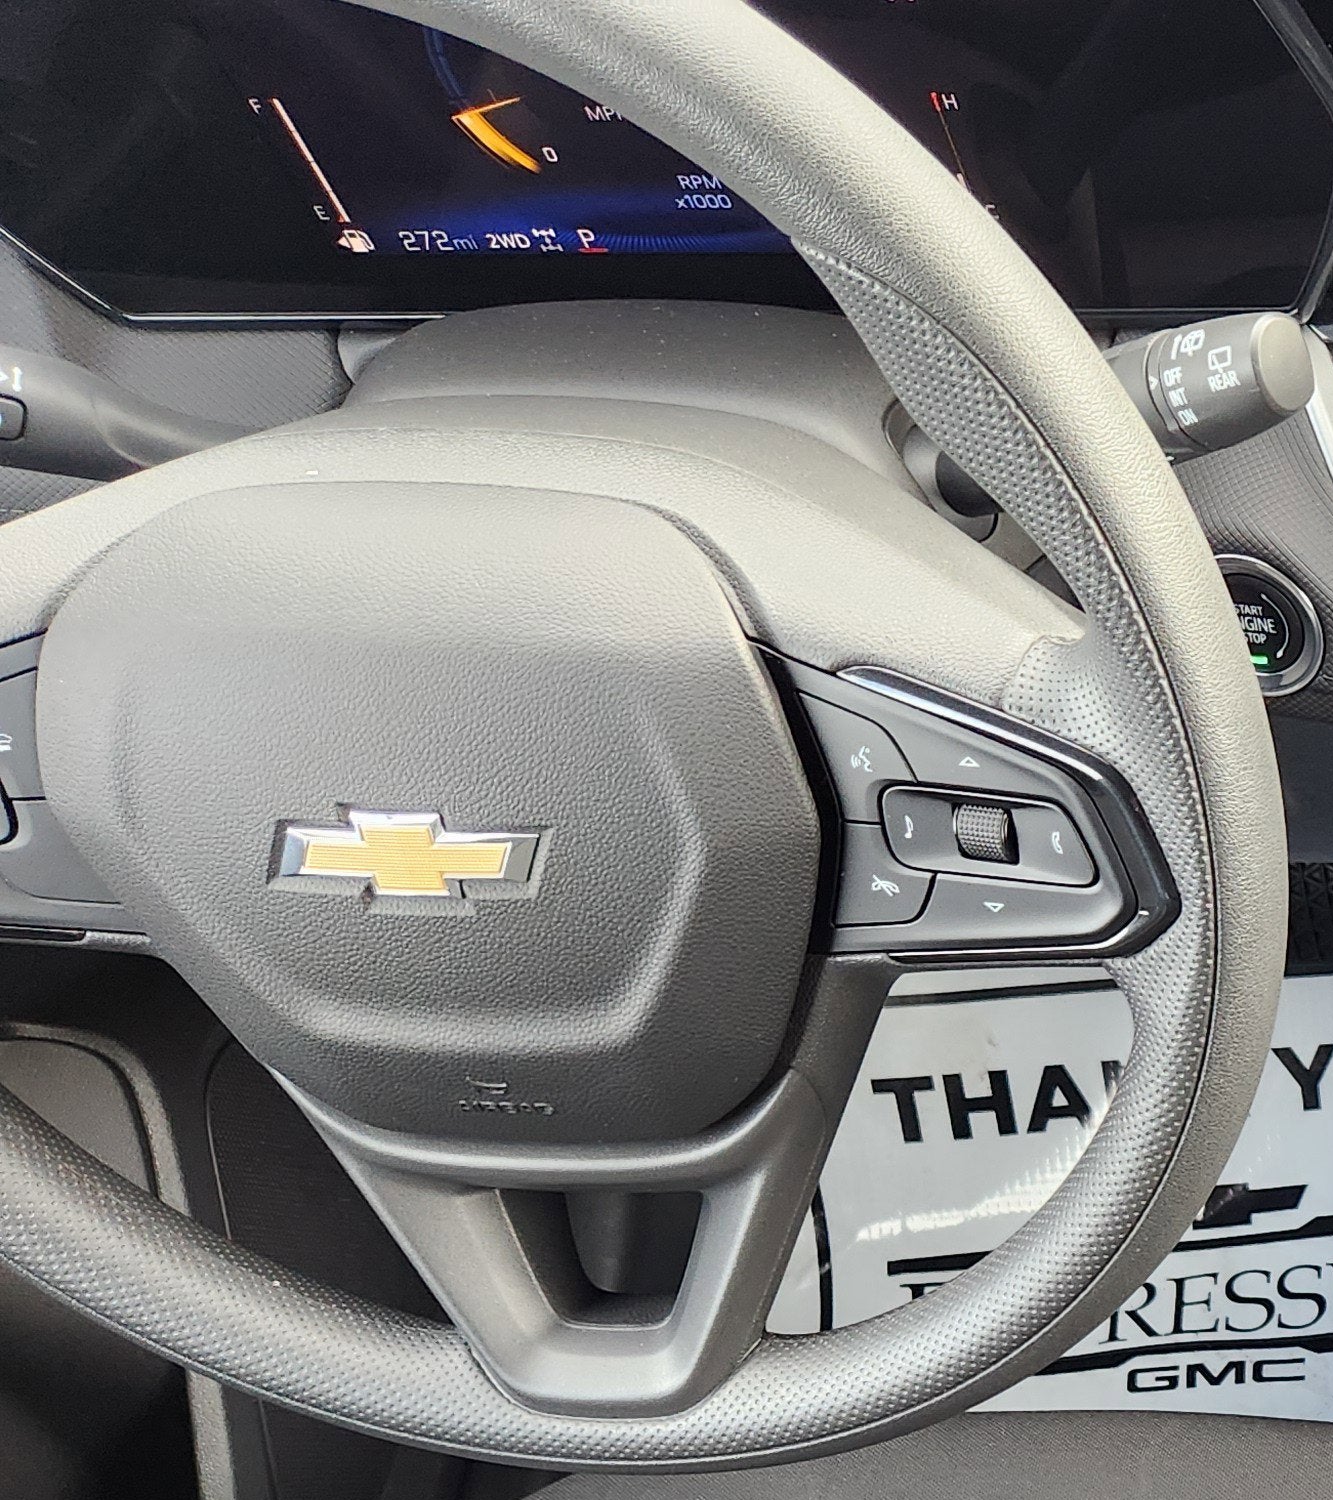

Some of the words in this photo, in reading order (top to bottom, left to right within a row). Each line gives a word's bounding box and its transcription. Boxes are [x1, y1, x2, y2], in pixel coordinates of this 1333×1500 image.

[248, 98, 262, 115] F
[941, 93, 959, 110] H
[583, 105, 622, 122] MP
[676, 175, 723, 190] RPM
[675, 195, 733, 210] x1000
[313, 205, 331, 221] E
[485, 233, 531, 250] 2WD
[576, 229, 596, 249] P
[1163, 366, 1183, 387] OFF
[1207, 371, 1241, 393] REAR
[1168, 387, 1188, 408] INT
[1177, 408, 1198, 426] ON
[1240, 616, 1277, 634] GINE
[1244, 632, 1267, 645] TOP
[871, 1060, 1124, 1144] THA
[1126, 1358, 1306, 1394] GMC
